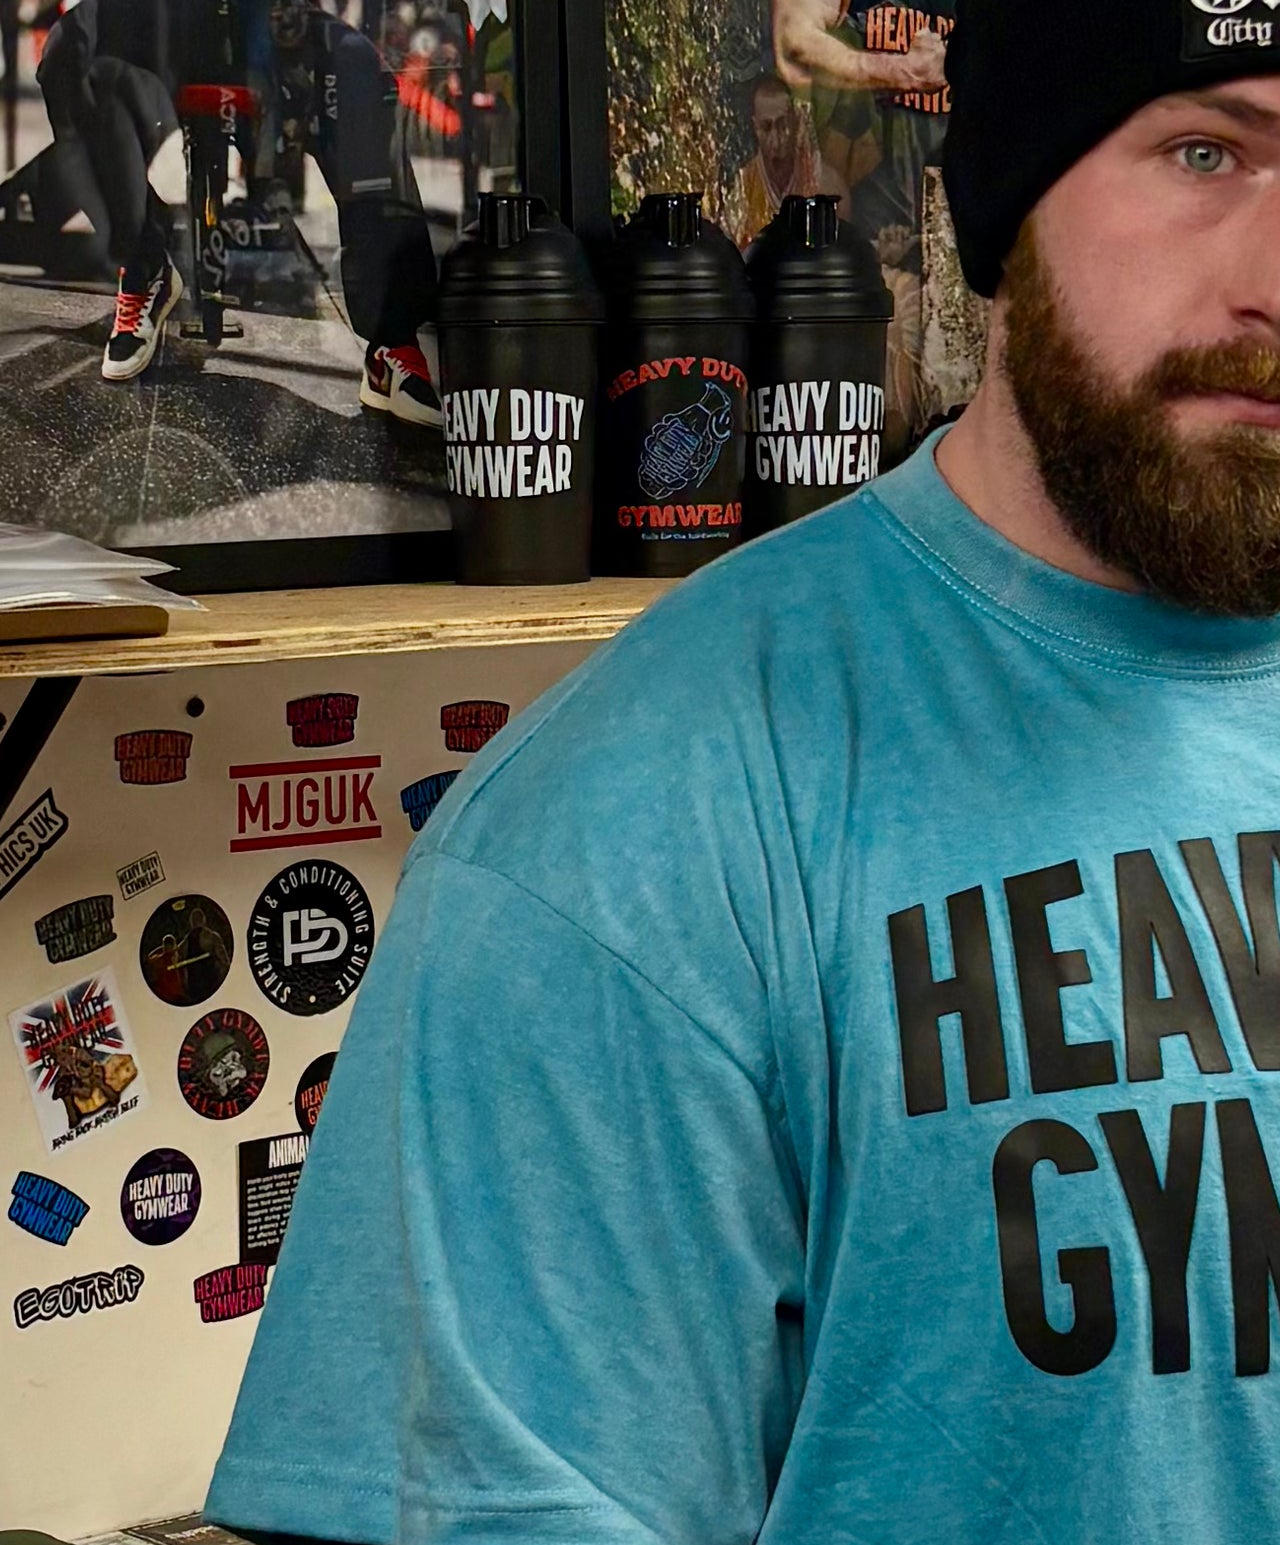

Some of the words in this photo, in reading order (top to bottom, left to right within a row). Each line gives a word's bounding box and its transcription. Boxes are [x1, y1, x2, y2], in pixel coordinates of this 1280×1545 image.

[1206, 16, 1273, 47] City
[606, 356, 697, 400] HEAVY
[701, 357, 750, 394] DUT
[442, 389, 500, 442] EAVY
[510, 388, 585, 442] DUTY
[445, 444, 572, 499] GYMWEAR
[755, 435, 882, 488] GYMWEAR
[28, 798, 62, 842] UK
[239, 773, 378, 834] MJGUK
[278, 864, 371, 935] CONDITIONING
[251, 915, 292, 1005] STRENGTH
[333, 943, 369, 996] SUITE
[14, 1173, 53, 1202] HEAVY
[53, 1191, 89, 1223] DUTY
[128, 1177, 165, 1204] HEAVY
[165, 1172, 195, 1196] DUTY
[132, 1193, 193, 1221] GYMWEAR
[9, 1196, 76, 1245] GYMWEAR
[17, 1267, 144, 1327] EGOTRIP
[195, 1267, 234, 1301] HEAVY
[234, 1264, 267, 1290] DUTY
[201, 1285, 264, 1321] GYMWEAR
